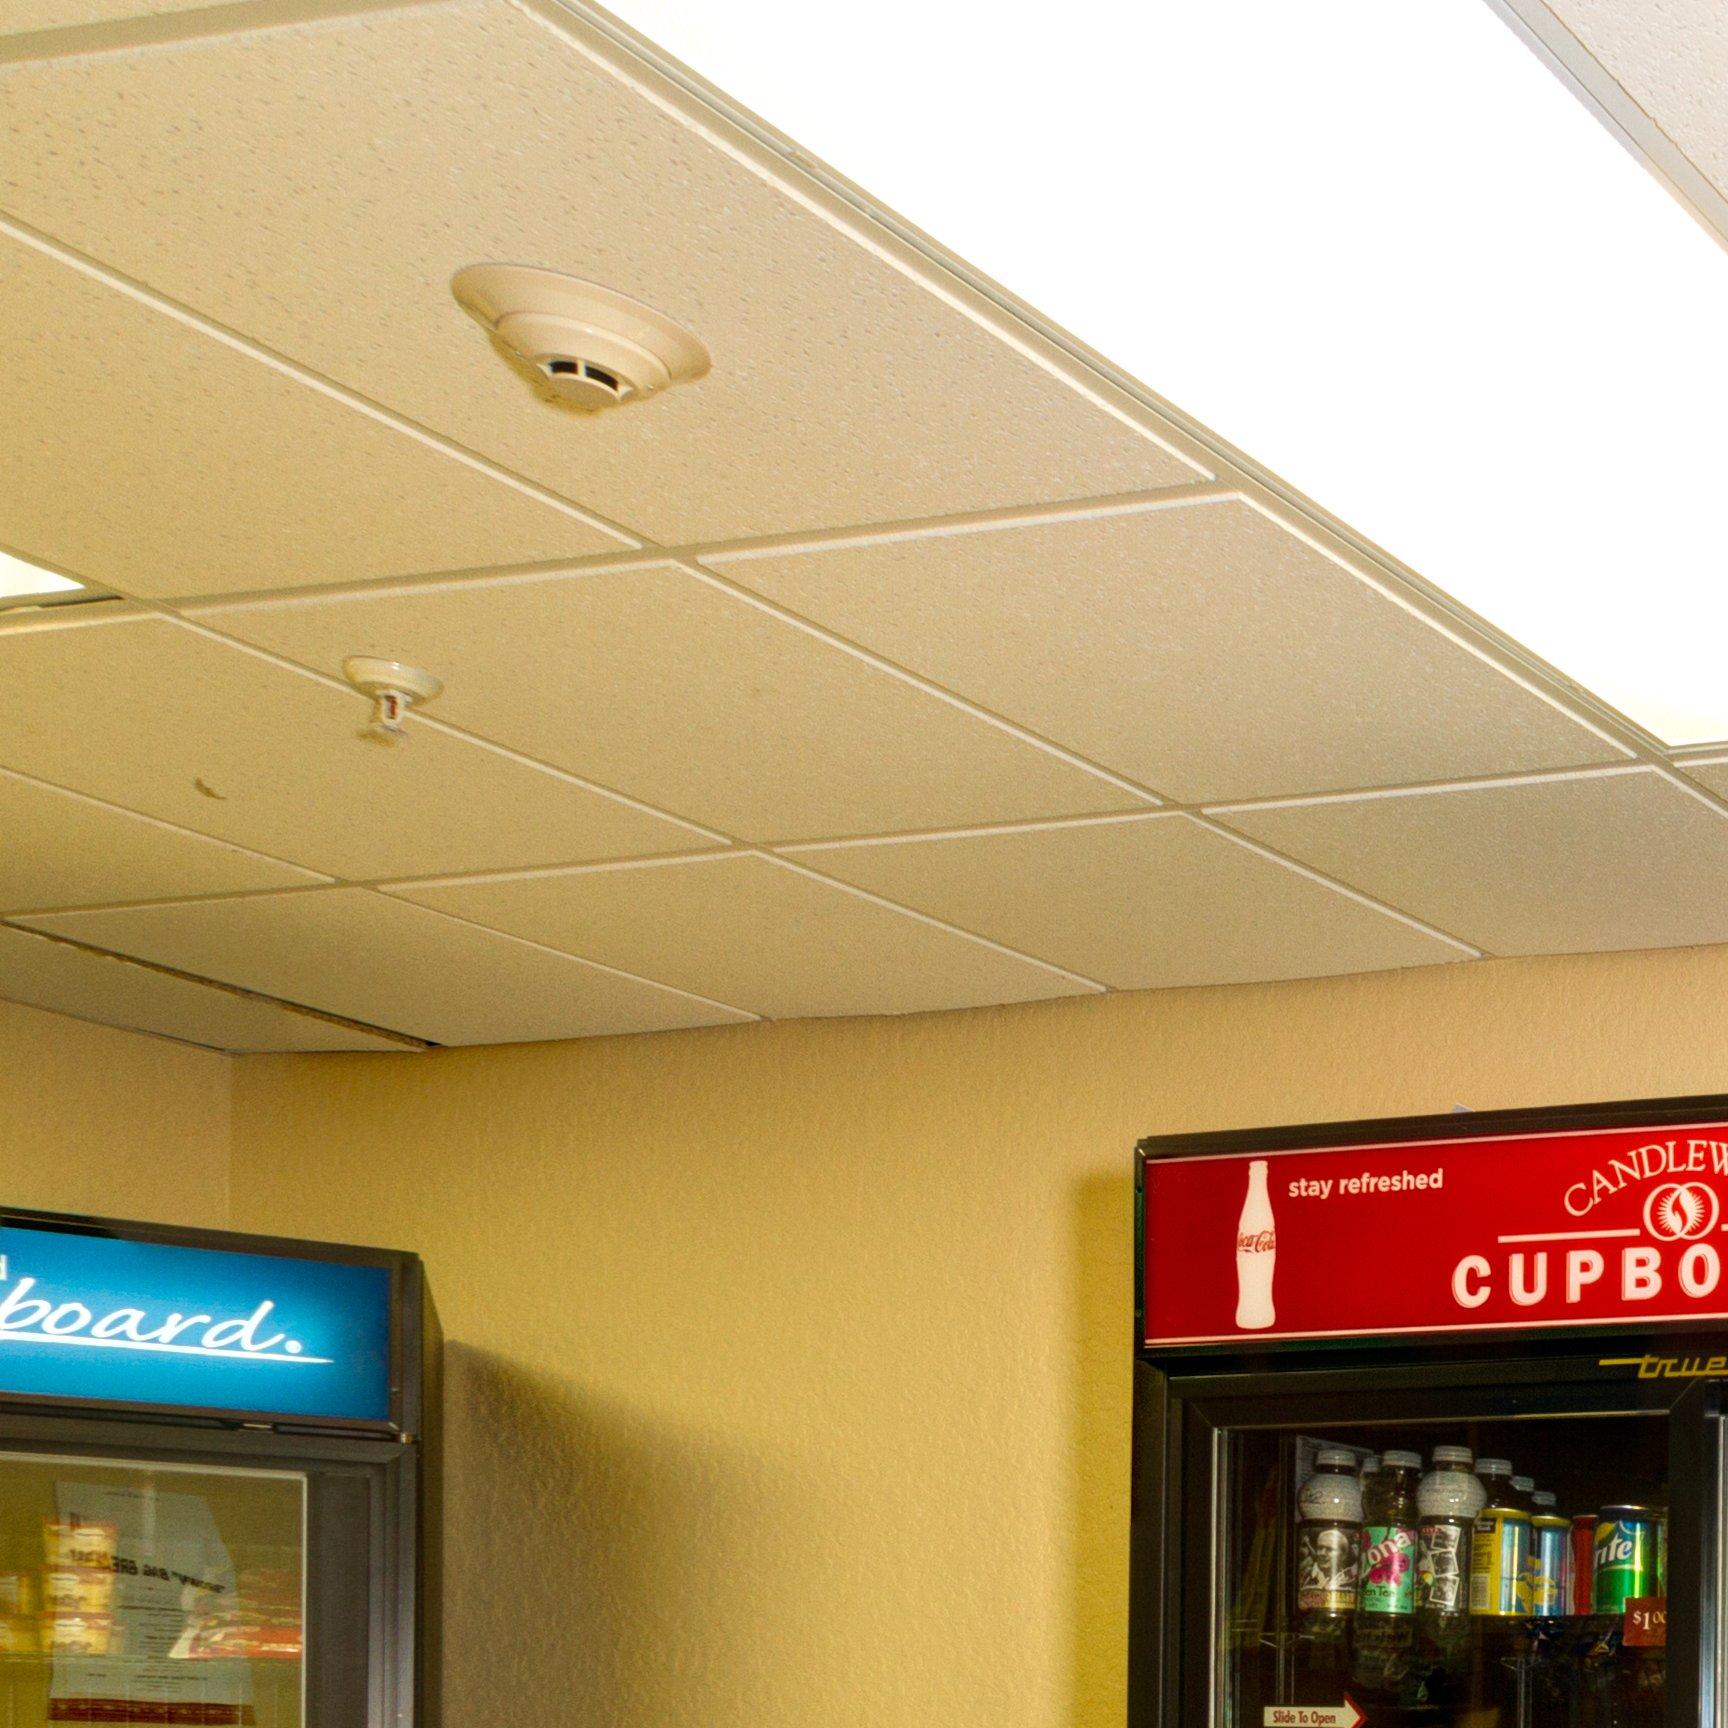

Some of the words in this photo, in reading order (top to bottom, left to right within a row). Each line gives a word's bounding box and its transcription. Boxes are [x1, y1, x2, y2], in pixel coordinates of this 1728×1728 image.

[1288, 1174, 1333, 1199] stay
[1339, 1168, 1443, 1196] refreshed
[1273, 1710, 1297, 1725] Slide
[1298, 1711, 1310, 1725] To
[1311, 1711, 1337, 1728] Open
